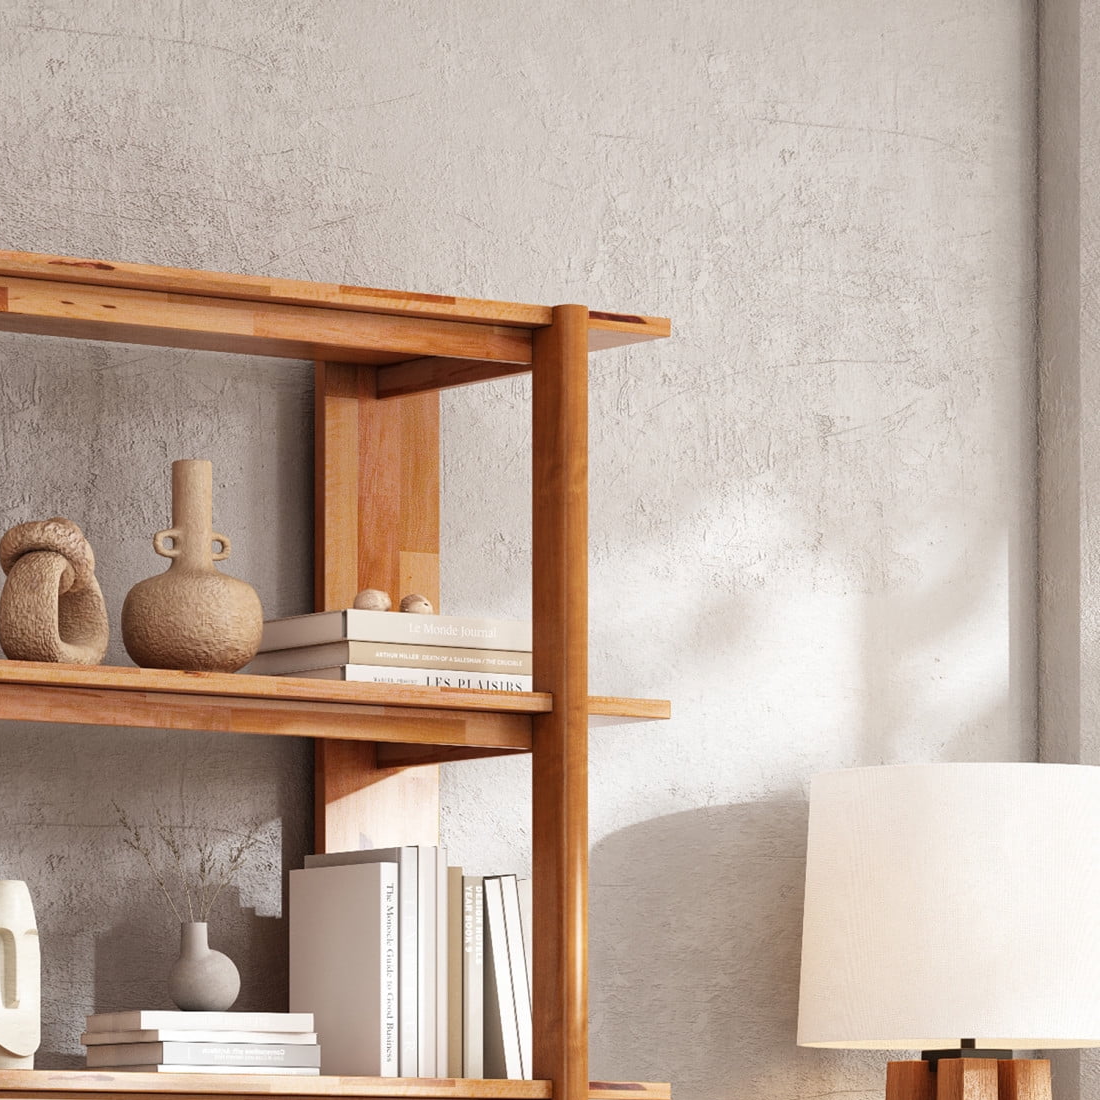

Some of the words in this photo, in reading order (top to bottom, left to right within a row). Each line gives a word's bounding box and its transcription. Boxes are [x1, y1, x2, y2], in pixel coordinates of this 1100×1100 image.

[409, 622, 421, 633] Le
[424, 623, 458, 637] Monde
[461, 626, 497, 639] Journal
[386, 883, 394, 903] The
[386, 906, 394, 945] Monocle
[386, 948, 394, 978] Guide
[386, 981, 394, 990] to
[386, 992, 394, 1019] Good
[386, 1022, 394, 1063] Business
